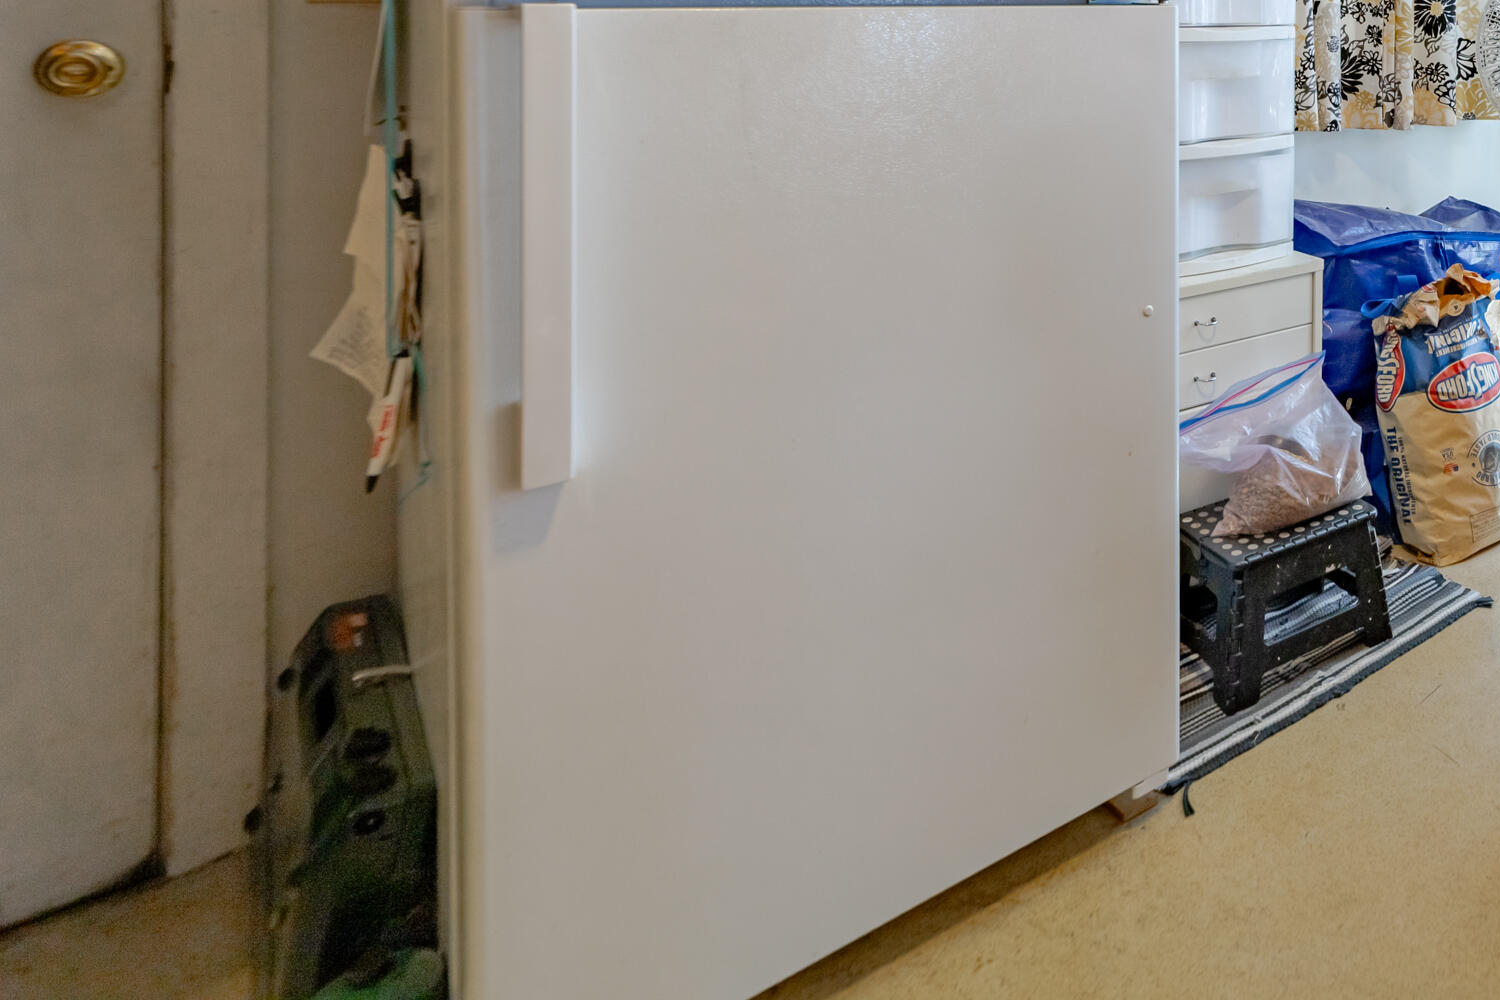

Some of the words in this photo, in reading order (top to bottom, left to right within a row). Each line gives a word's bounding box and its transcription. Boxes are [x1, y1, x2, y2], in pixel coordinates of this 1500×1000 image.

[1436, 361, 1500, 400] KINGSFORD
[1386, 426, 1399, 452] THE
[1391, 457, 1412, 524] ORIGINAL
